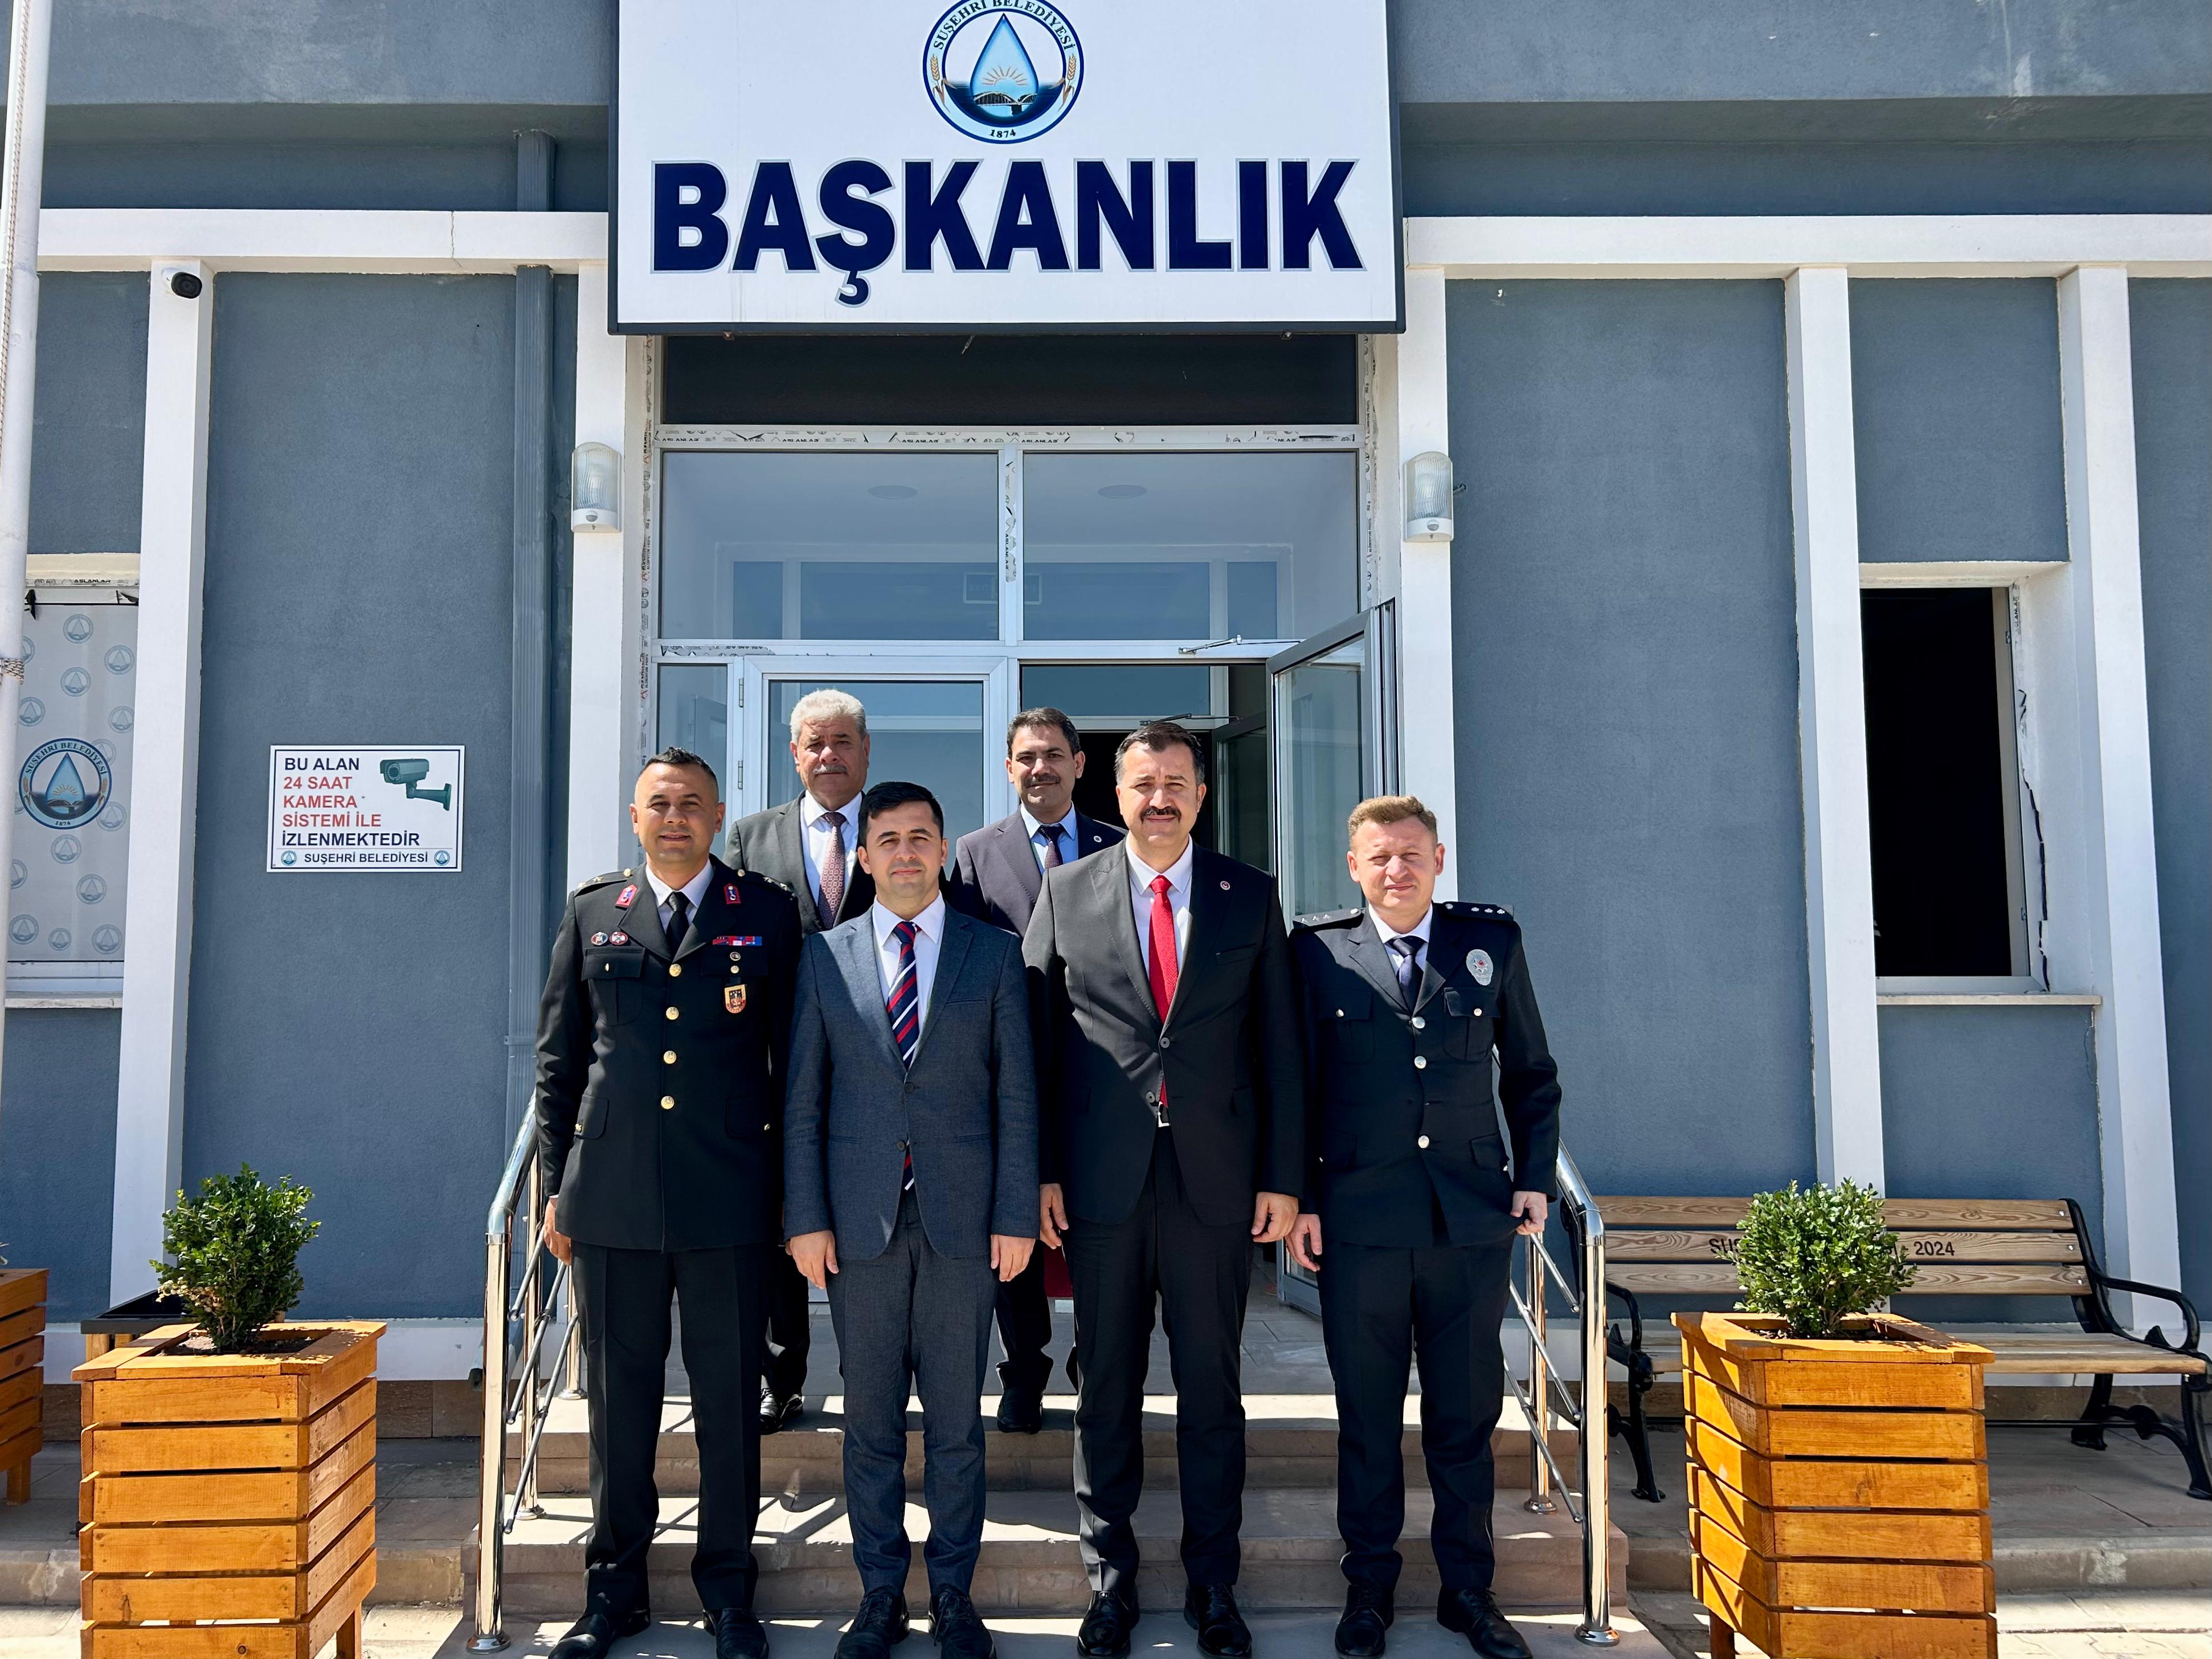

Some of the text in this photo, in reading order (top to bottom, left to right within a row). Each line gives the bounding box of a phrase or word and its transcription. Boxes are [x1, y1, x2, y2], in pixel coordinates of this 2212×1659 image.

[992, 0, 1077, 51] BELEDİYESİ
[989, 128, 1016, 138] 1874
[651, 157, 1367, 307] BAŞKANLIK
[26, 742, 108, 775] SUŞEHRİ BELEDİYESİ
[285, 758, 359, 771] BU ALAN
[283, 776, 353, 790] 24 SAAT
[283, 795, 358, 808] KAMERA
[283, 811, 382, 827] SİSTEMİ İLE
[282, 830, 420, 847] İZLENMEKTEDİR
[304, 851, 428, 865] SUŞEHRİ BELEDİYESİ
[1913, 1241, 1955, 1256] 2024
